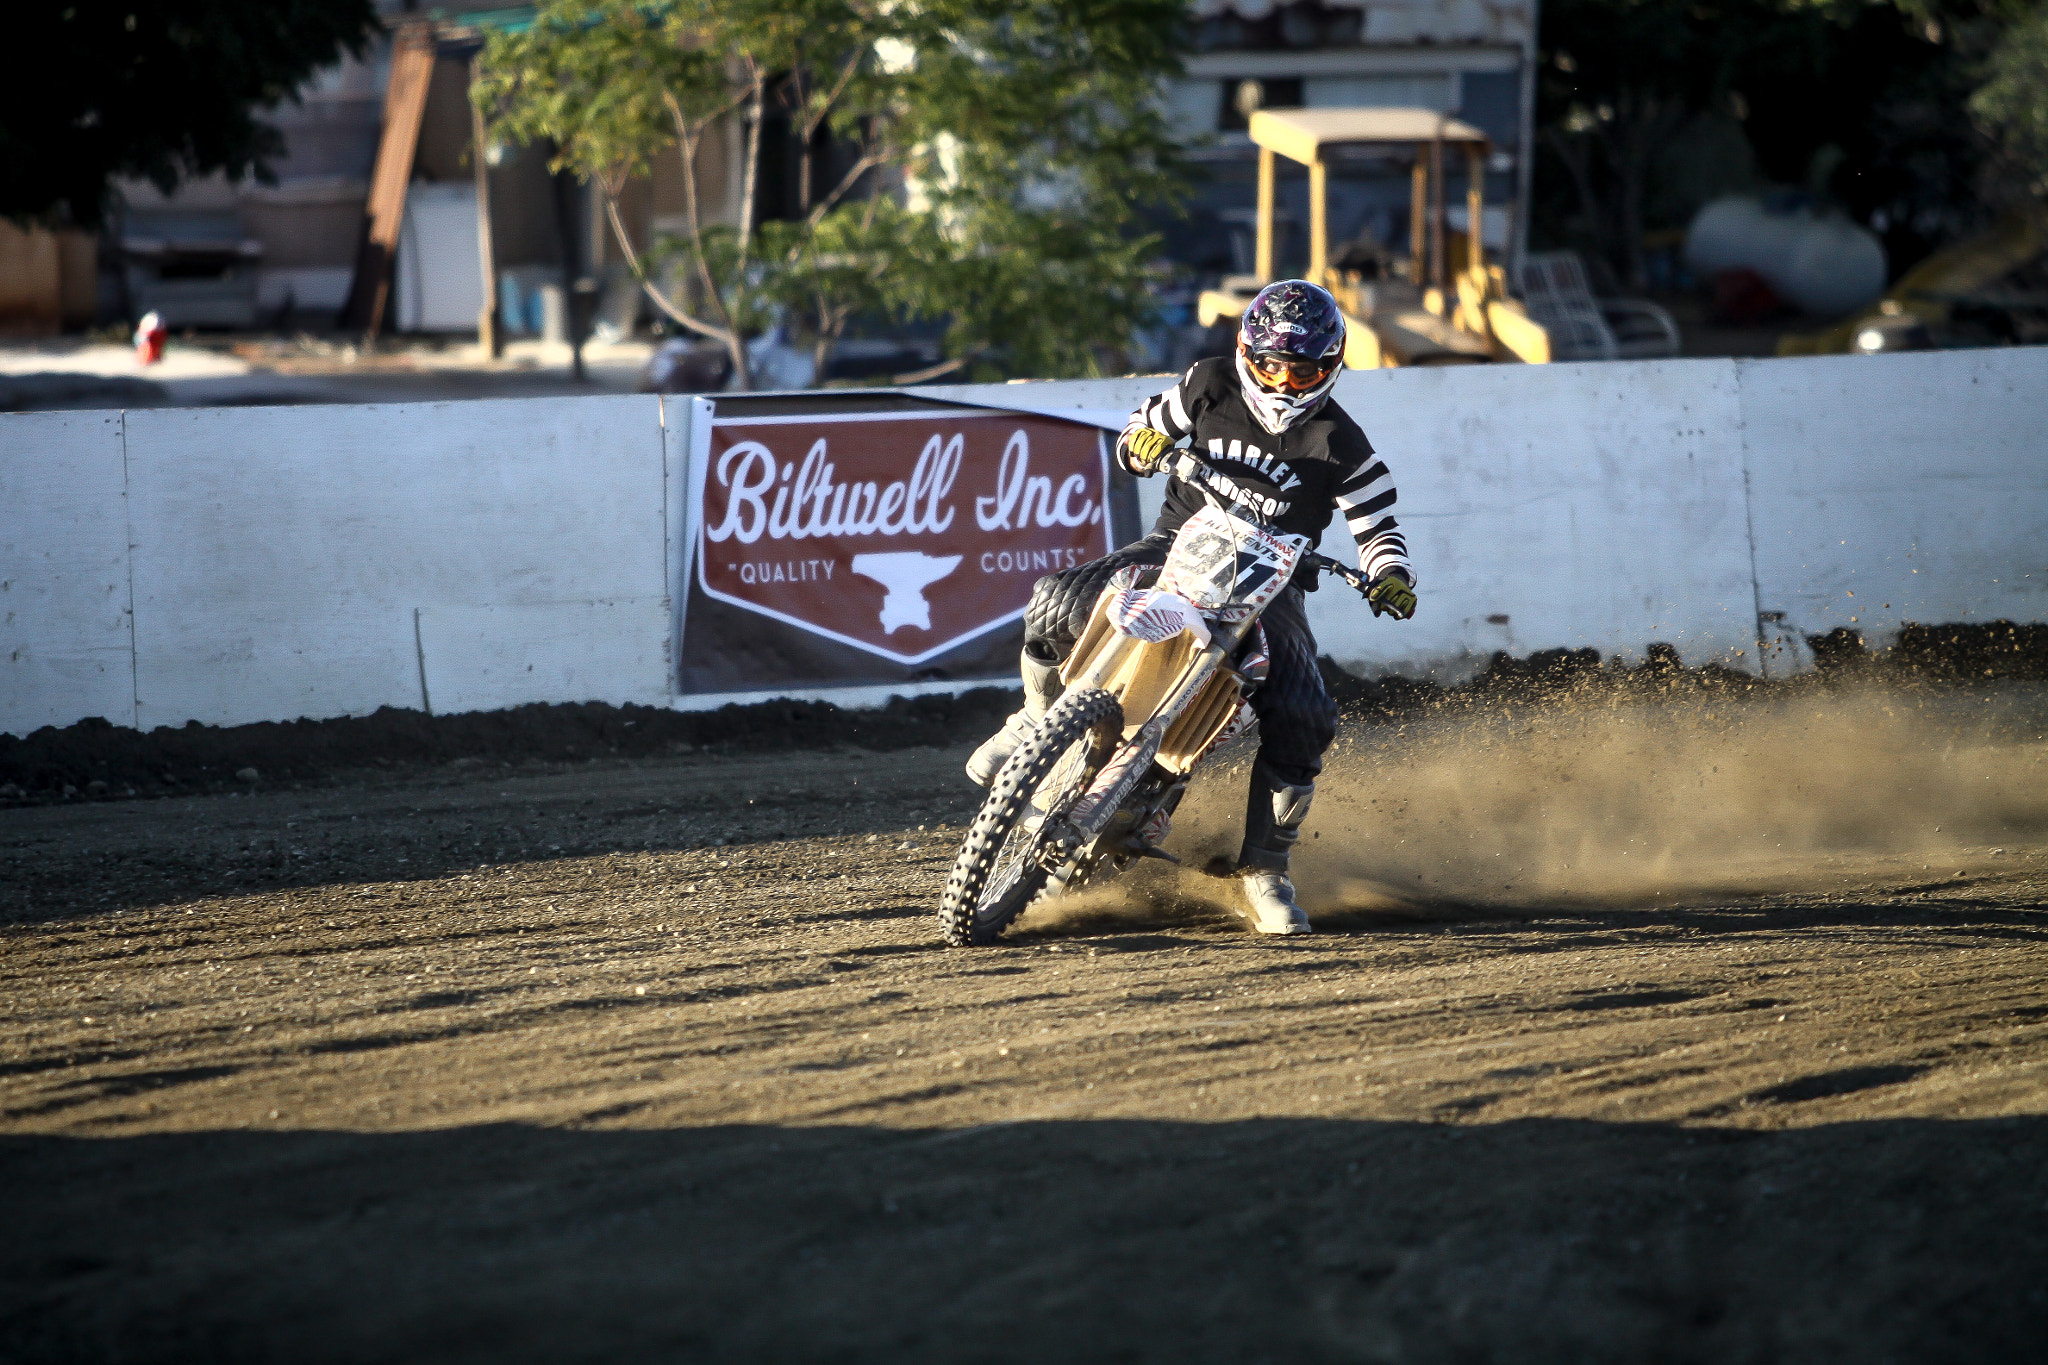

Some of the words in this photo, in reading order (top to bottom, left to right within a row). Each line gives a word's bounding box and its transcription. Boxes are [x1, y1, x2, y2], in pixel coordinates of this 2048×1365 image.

[707, 433, 963, 544] Biltwell
[976, 429, 1101, 532] Inc.
[1208, 438, 1302, 492] HARLEY
